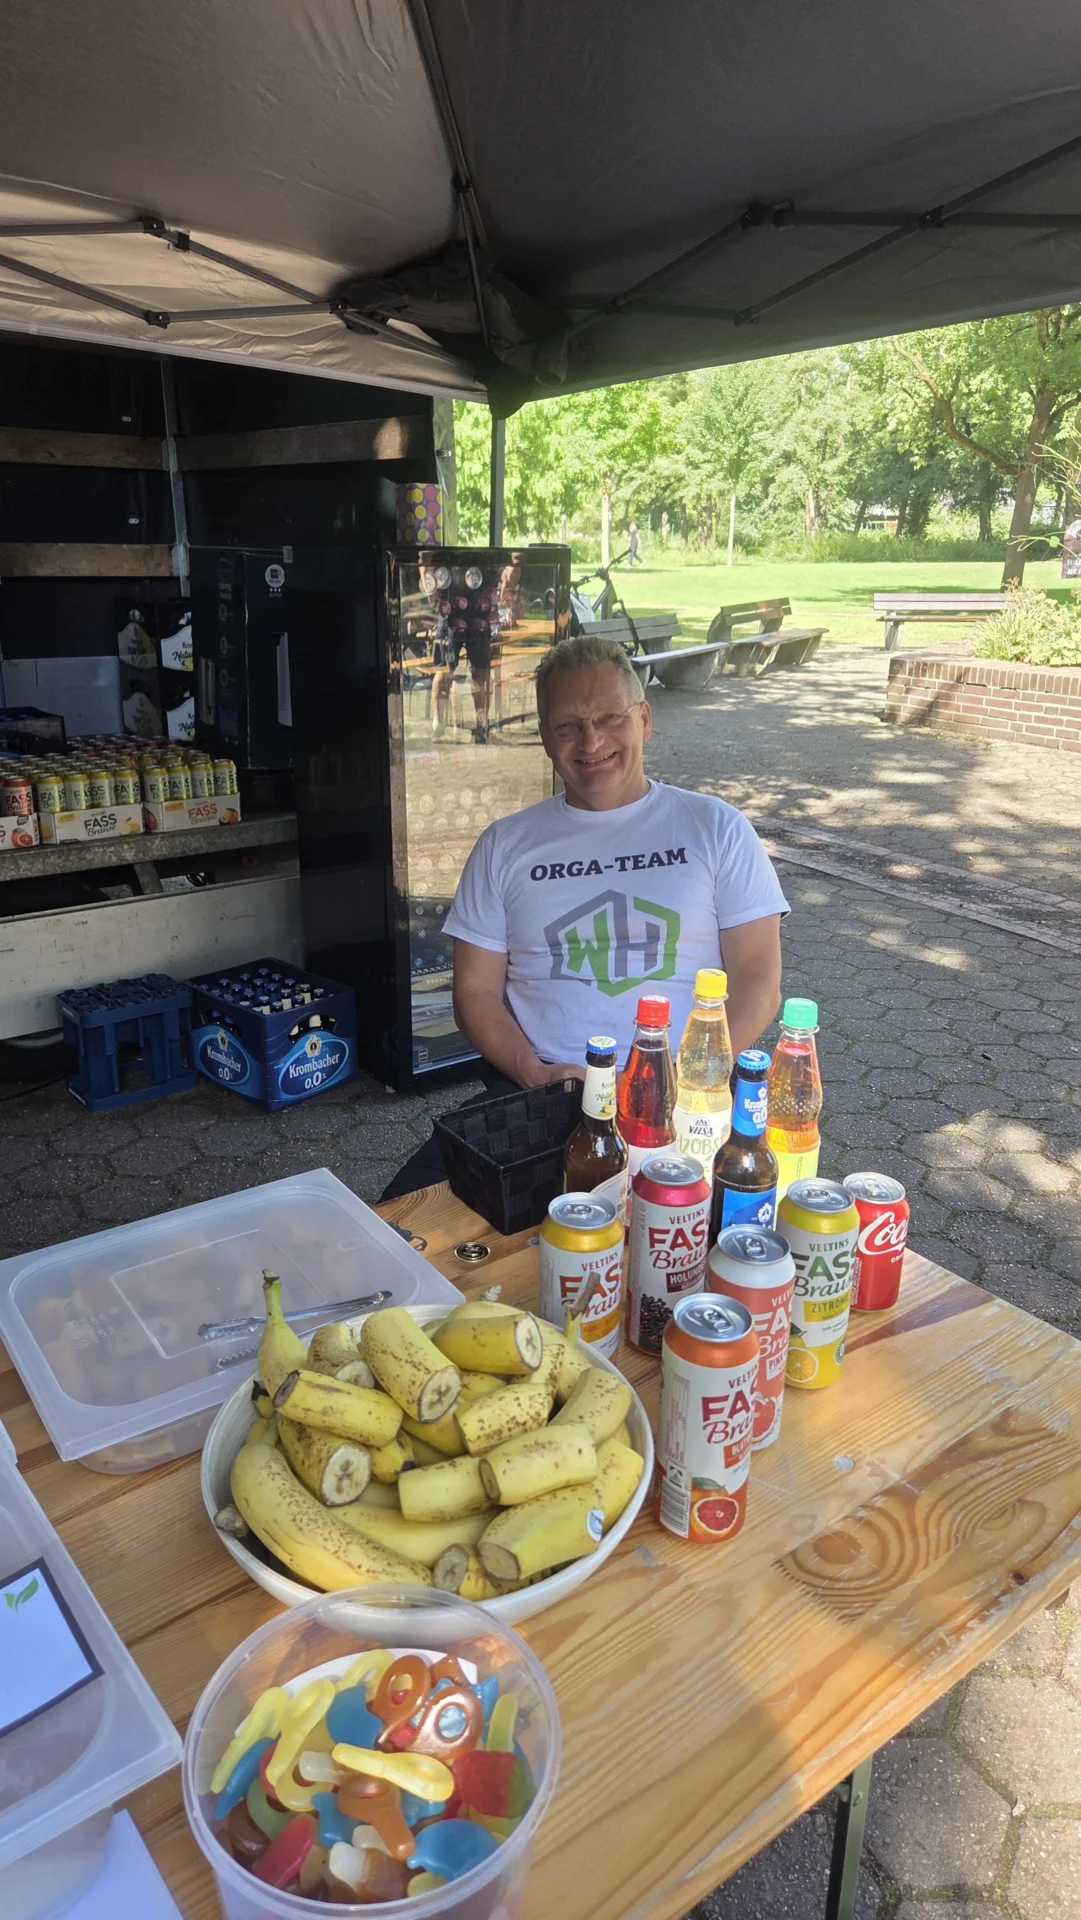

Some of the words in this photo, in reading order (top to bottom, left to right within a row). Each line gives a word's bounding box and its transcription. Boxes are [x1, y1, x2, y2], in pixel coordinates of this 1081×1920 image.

[189, 803, 218, 818] FASS
[84, 813, 117, 831] FASS
[86, 825, 117, 837] Brause
[530, 847, 688, 881] ORGA-TEAM
[206, 1045, 241, 1073] Krombacher
[289, 1053, 340, 1079] Krombacher
[688, 1124, 714, 1137] VILSA
[669, 1207, 704, 1225] VELTINS
[648, 1213, 711, 1252] FAS
[809, 1238, 849, 1252] VELTINS
[581, 1250, 618, 1272] VELTINS
[794, 1275, 851, 1298] Brau
[752, 1304, 792, 1335] FA
[702, 1416, 751, 1444] Bra
